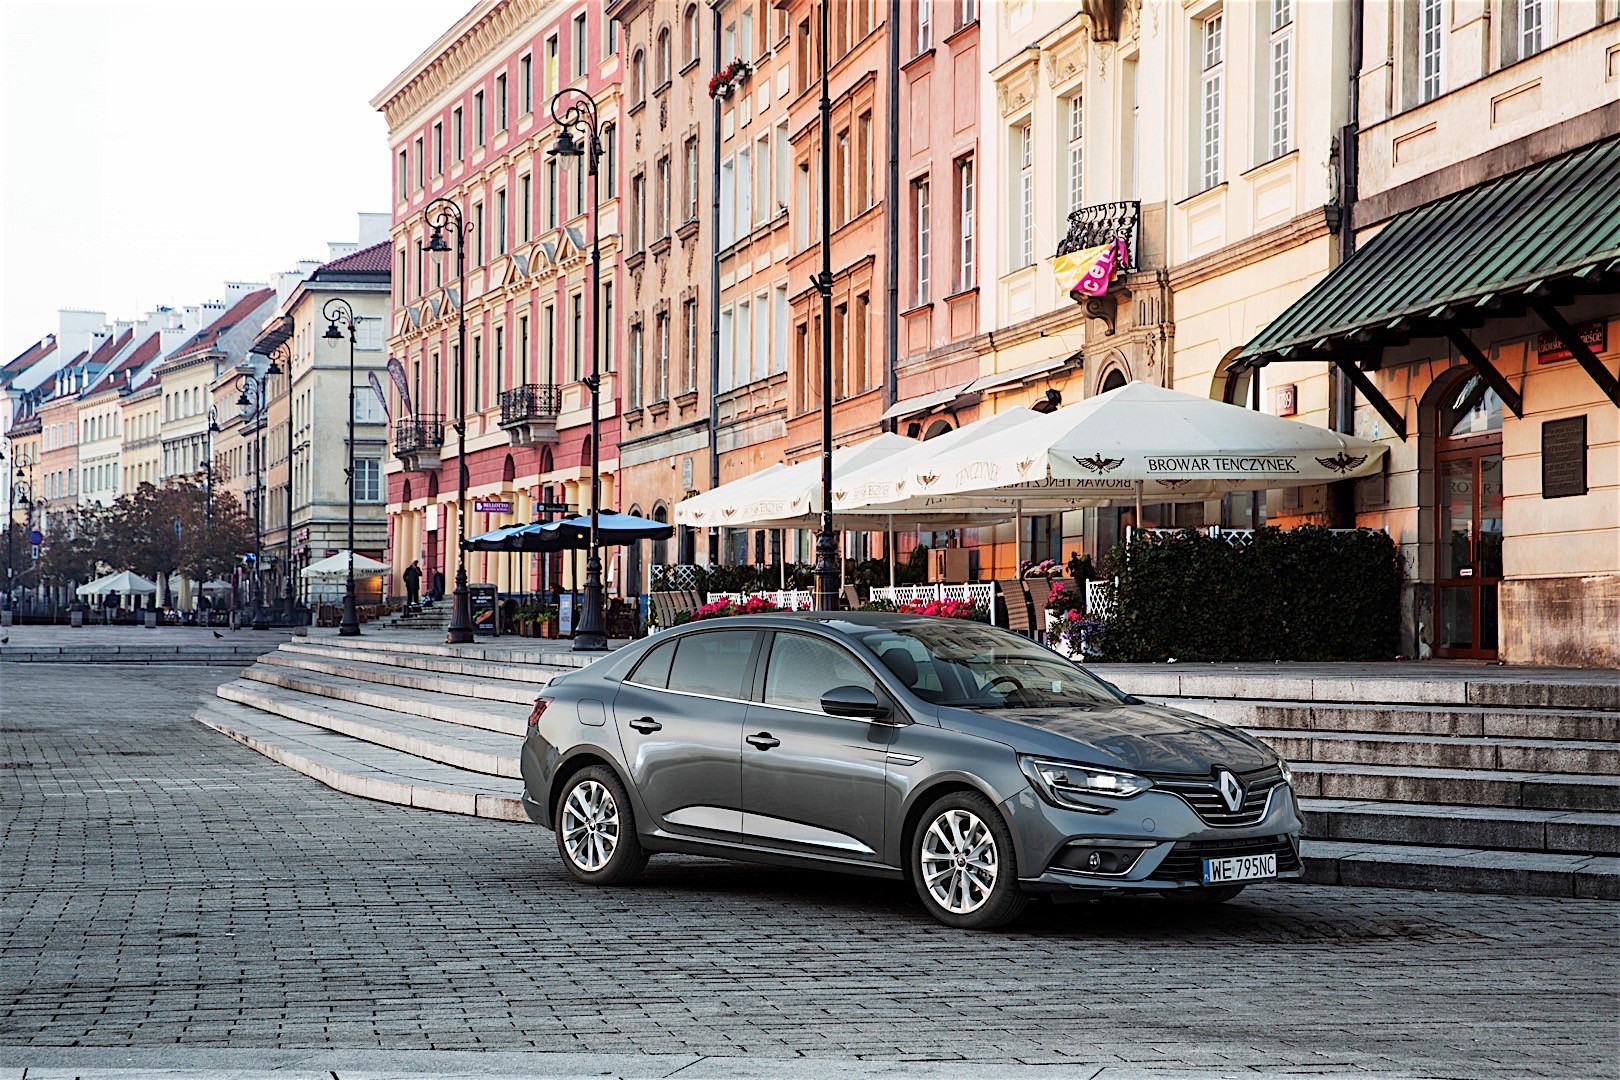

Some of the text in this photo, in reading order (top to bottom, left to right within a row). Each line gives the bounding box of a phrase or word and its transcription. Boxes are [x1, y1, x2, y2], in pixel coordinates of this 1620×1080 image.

[1148, 458, 1296, 471] BROWAR TENCZYNEK
[1211, 860, 1232, 880] WE
[1236, 855, 1275, 878] 795NC
